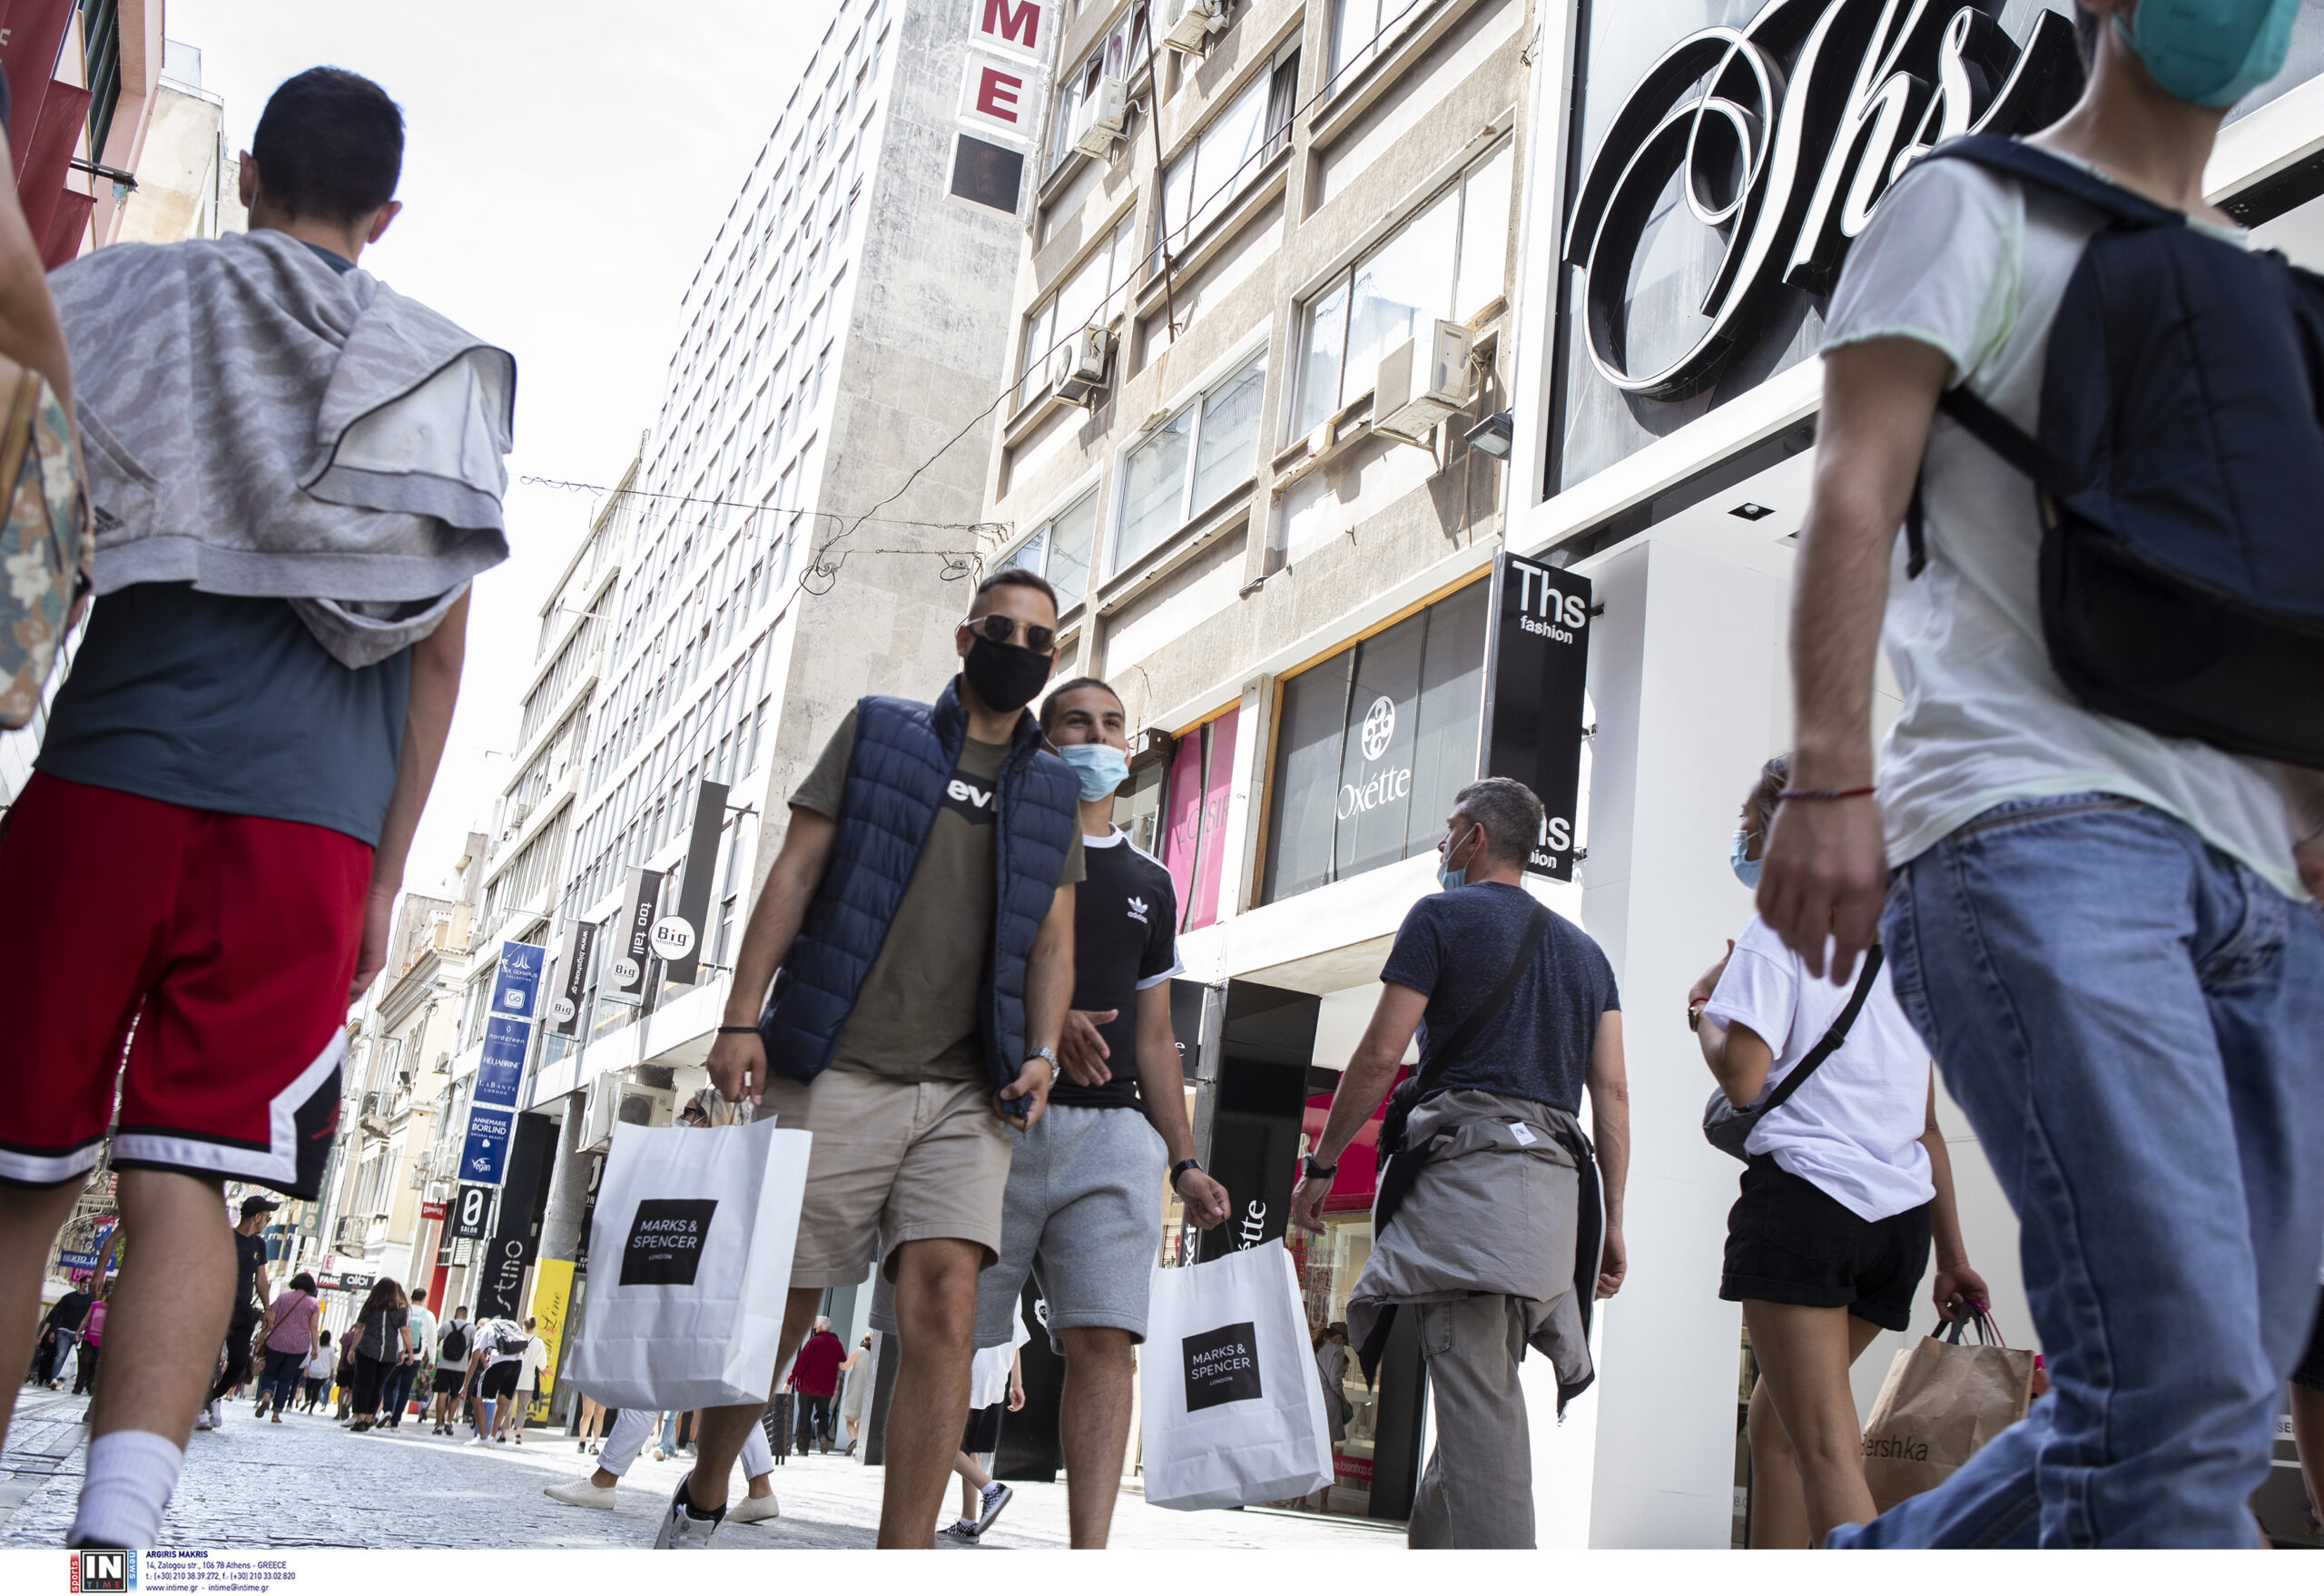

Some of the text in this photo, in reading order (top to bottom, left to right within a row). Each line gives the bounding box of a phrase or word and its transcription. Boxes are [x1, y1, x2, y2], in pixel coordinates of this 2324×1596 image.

[1512, 560, 1586, 629] Ths
[1520, 615, 1573, 645] fashion
[1337, 765, 1411, 820] Oxétte
[1128, 911, 1147, 924] adidas
[633, 901, 653, 955] too tall
[658, 927, 687, 947] Big
[572, 931, 589, 995] www.bigshoes.gr
[615, 964, 635, 978] Big
[508, 992, 521, 1002] Go
[555, 1003, 572, 1015] Big
[488, 1033, 525, 1044] nordgreen
[484, 1088, 507, 1096] LONDON
[473, 1117, 507, 1127] ANNEMARIE
[471, 1158, 491, 1172] Vegan
[459, 1226, 478, 1234] SALON
[640, 1219, 698, 1233] MARKS &
[1237, 1200, 1266, 1252] étte
[633, 1235, 697, 1249] SPENCER
[1192, 1343, 1246, 1365] MARKS &
[1191, 1357, 1251, 1380] SPENCER
[1209, 1375, 1234, 1386] LONDON
